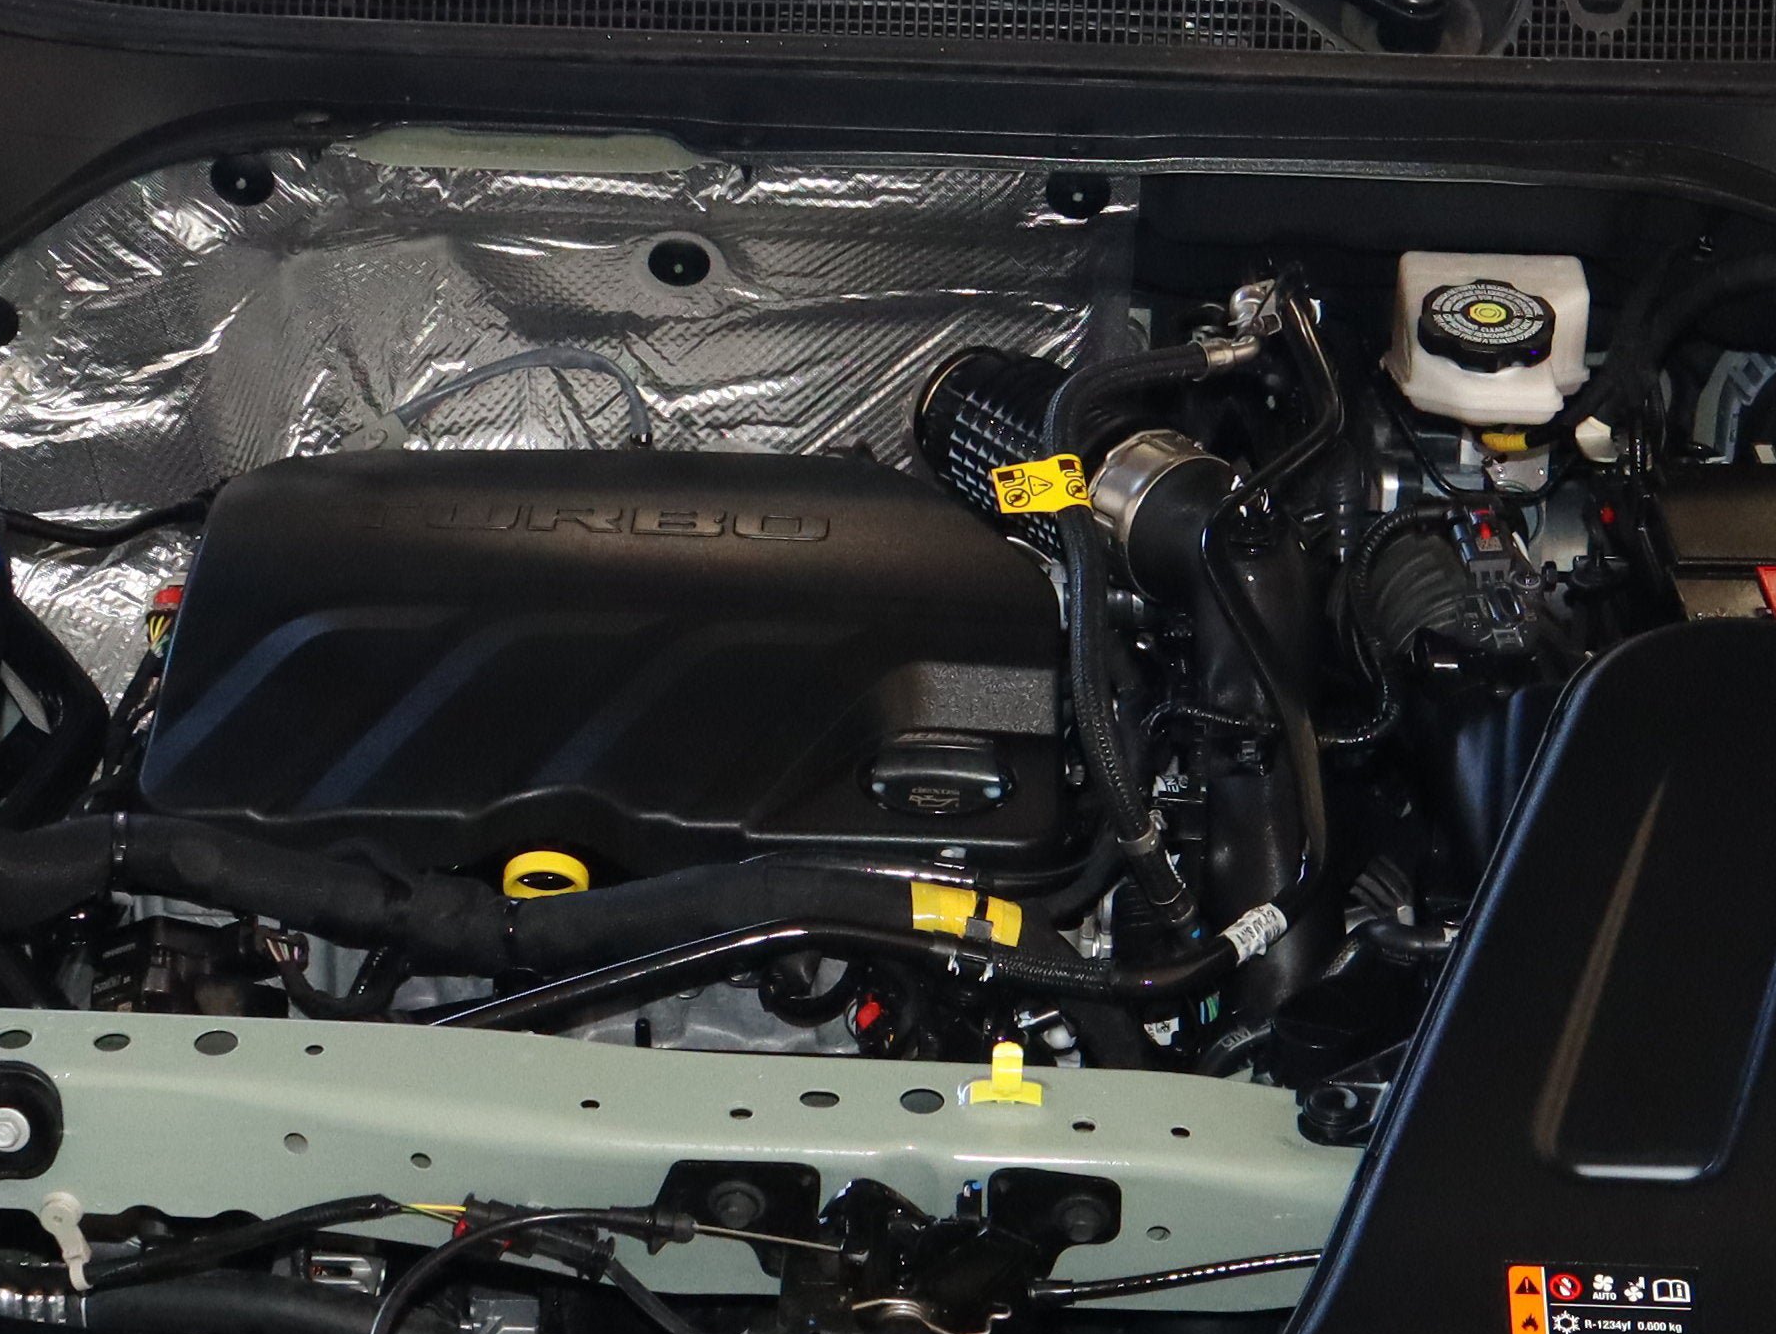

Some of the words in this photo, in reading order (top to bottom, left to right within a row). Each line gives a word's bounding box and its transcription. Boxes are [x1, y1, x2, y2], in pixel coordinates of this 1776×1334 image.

[329, 504, 830, 542] TURBO
[1592, 1292, 1617, 1301] AUTO
[1668, 1322, 1683, 1334] kg
